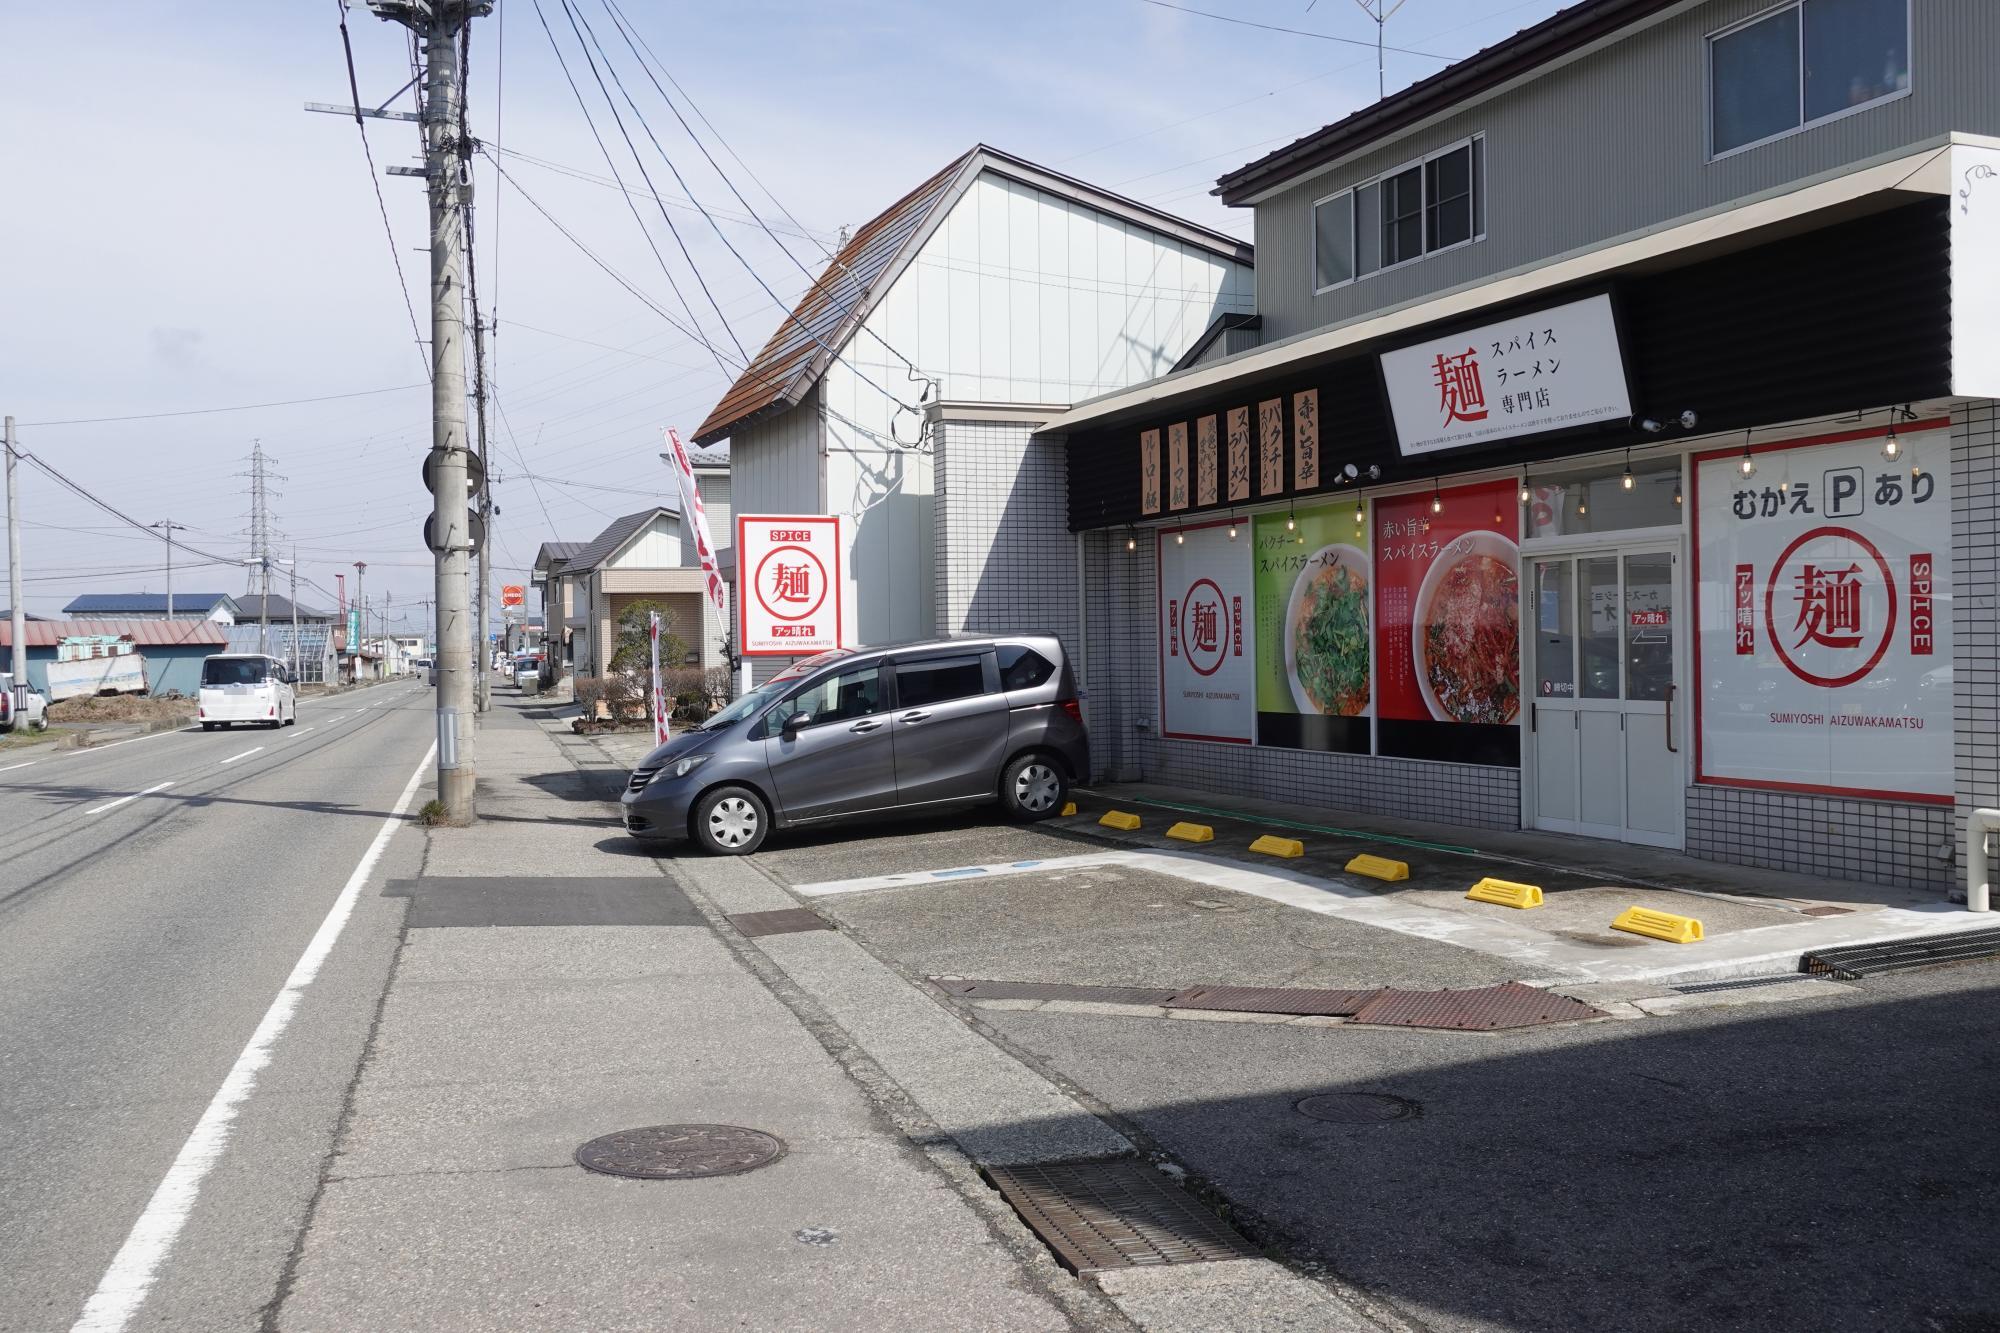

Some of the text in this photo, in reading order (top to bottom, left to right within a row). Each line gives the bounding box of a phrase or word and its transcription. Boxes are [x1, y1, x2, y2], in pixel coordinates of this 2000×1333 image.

[1491, 328, 1556, 359] スパイス
[1431, 346, 1489, 429] 麺
[1497, 358, 1560, 386] ラーメン
[1501, 387, 1550, 414] 専門店
[1238, 409, 1248, 484] スパイス
[1269, 403, 1281, 488] パクチー
[1298, 395, 1315, 485] 赤い旨辛
[1229, 432, 1240, 498] ラーメン
[1733, 472, 1935, 520] むかえ P あり
[772, 531, 811, 542] SPICE
[1259, 536, 1295, 550] パクチー
[1383, 517, 1429, 539] 赤い旨辛
[1261, 552, 1340, 574] スパイスラーメン
[1383, 539, 1476, 562] スパイスラーメン
[772, 563, 811, 604] 麺
[1913, 562, 1930, 648] SPICE
[1192, 601, 1218, 653] 麺
[1234, 601, 1242, 652] SPICE
[1737, 571, 1753, 647] アッ晴れ
[1793, 562, 1864, 650] 麺
[774, 626, 814, 637] アッ晴れ
[1770, 712, 1924, 730] SUMIYOSHI AIZUWAKAMATSU
